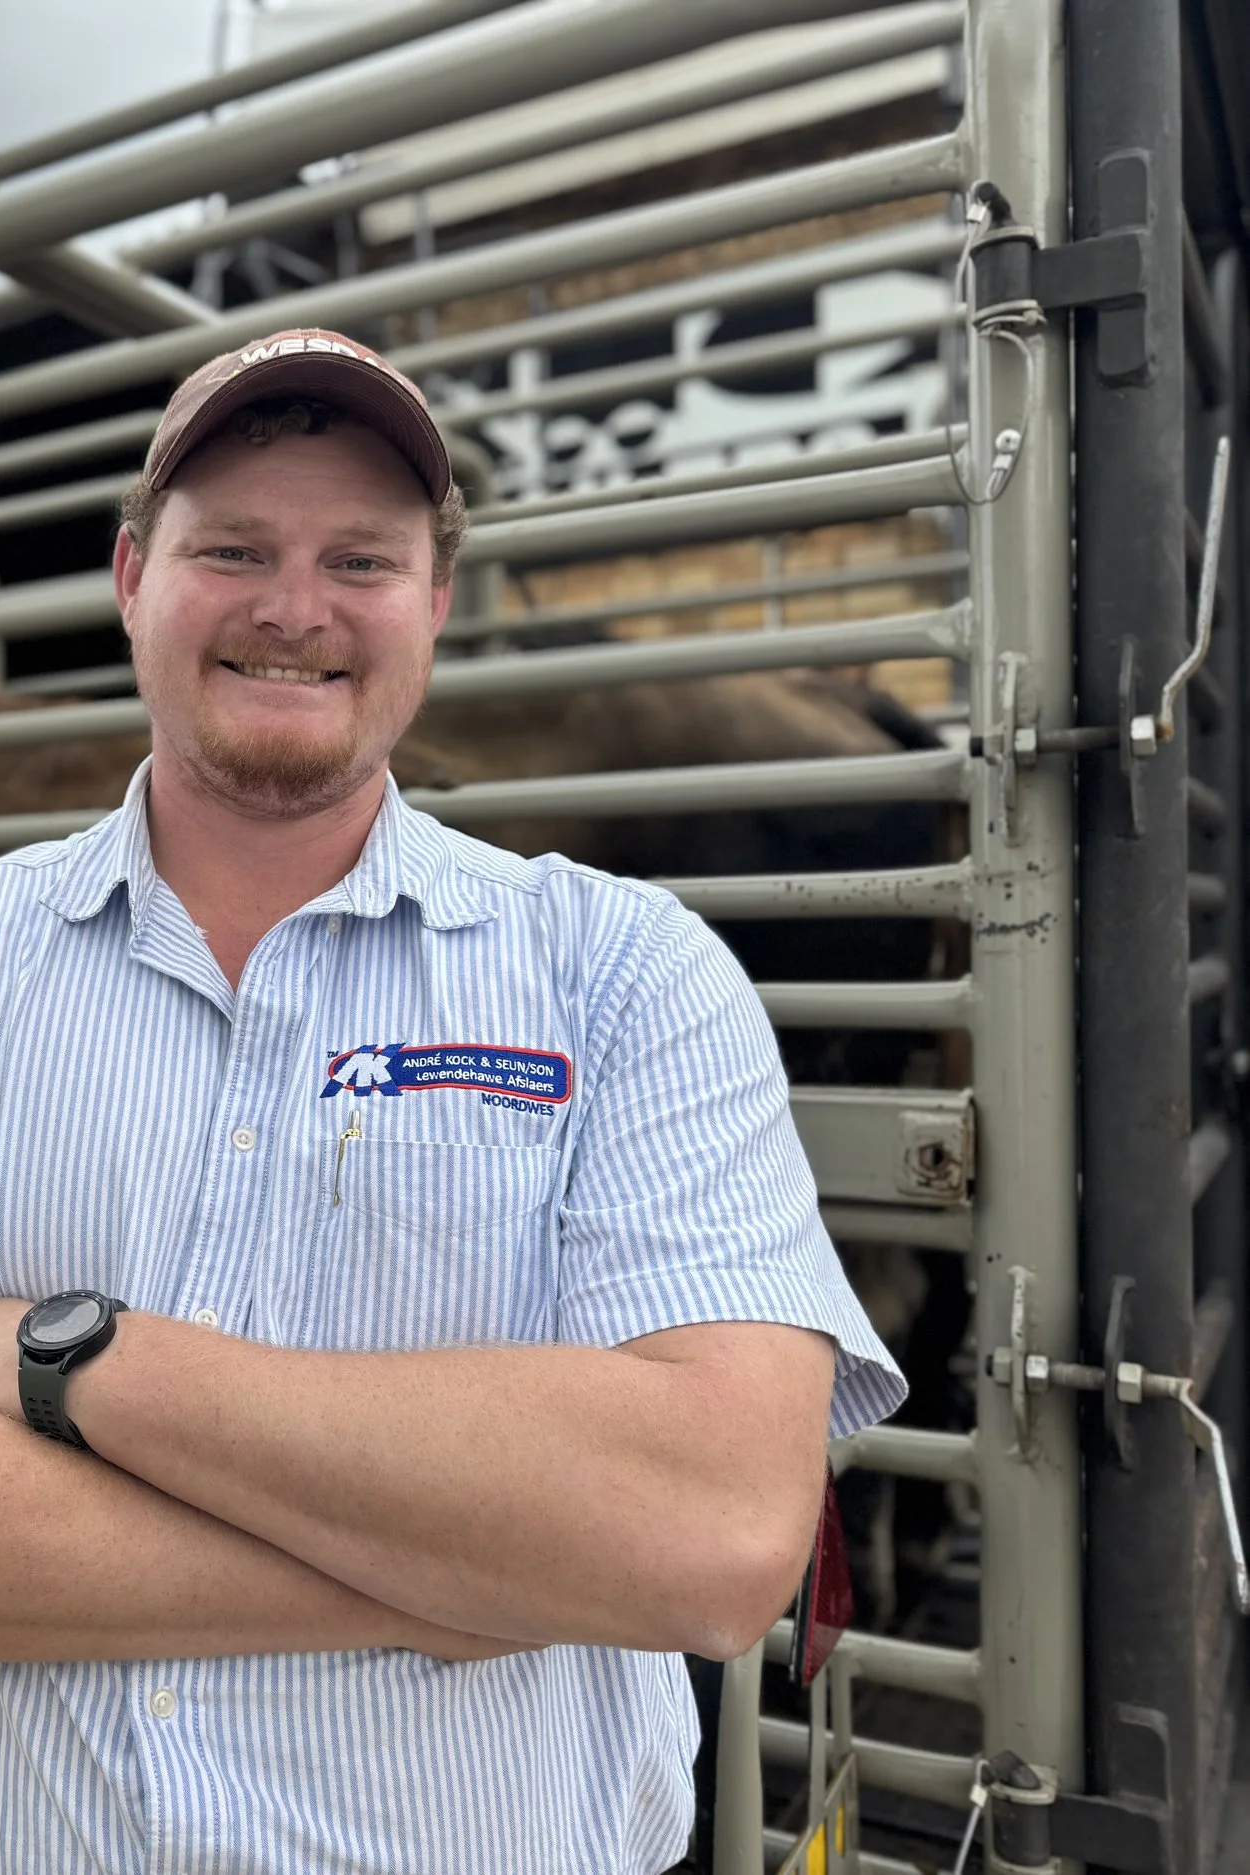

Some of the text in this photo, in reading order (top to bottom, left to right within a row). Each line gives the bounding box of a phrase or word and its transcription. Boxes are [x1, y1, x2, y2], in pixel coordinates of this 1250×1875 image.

[402, 1052, 555, 1077] ANDRÉ KOCK & SEUN/SON
[416, 1068, 555, 1093] Lewendehawe Afslaers
[481, 1092, 555, 1117] NOORDWES
